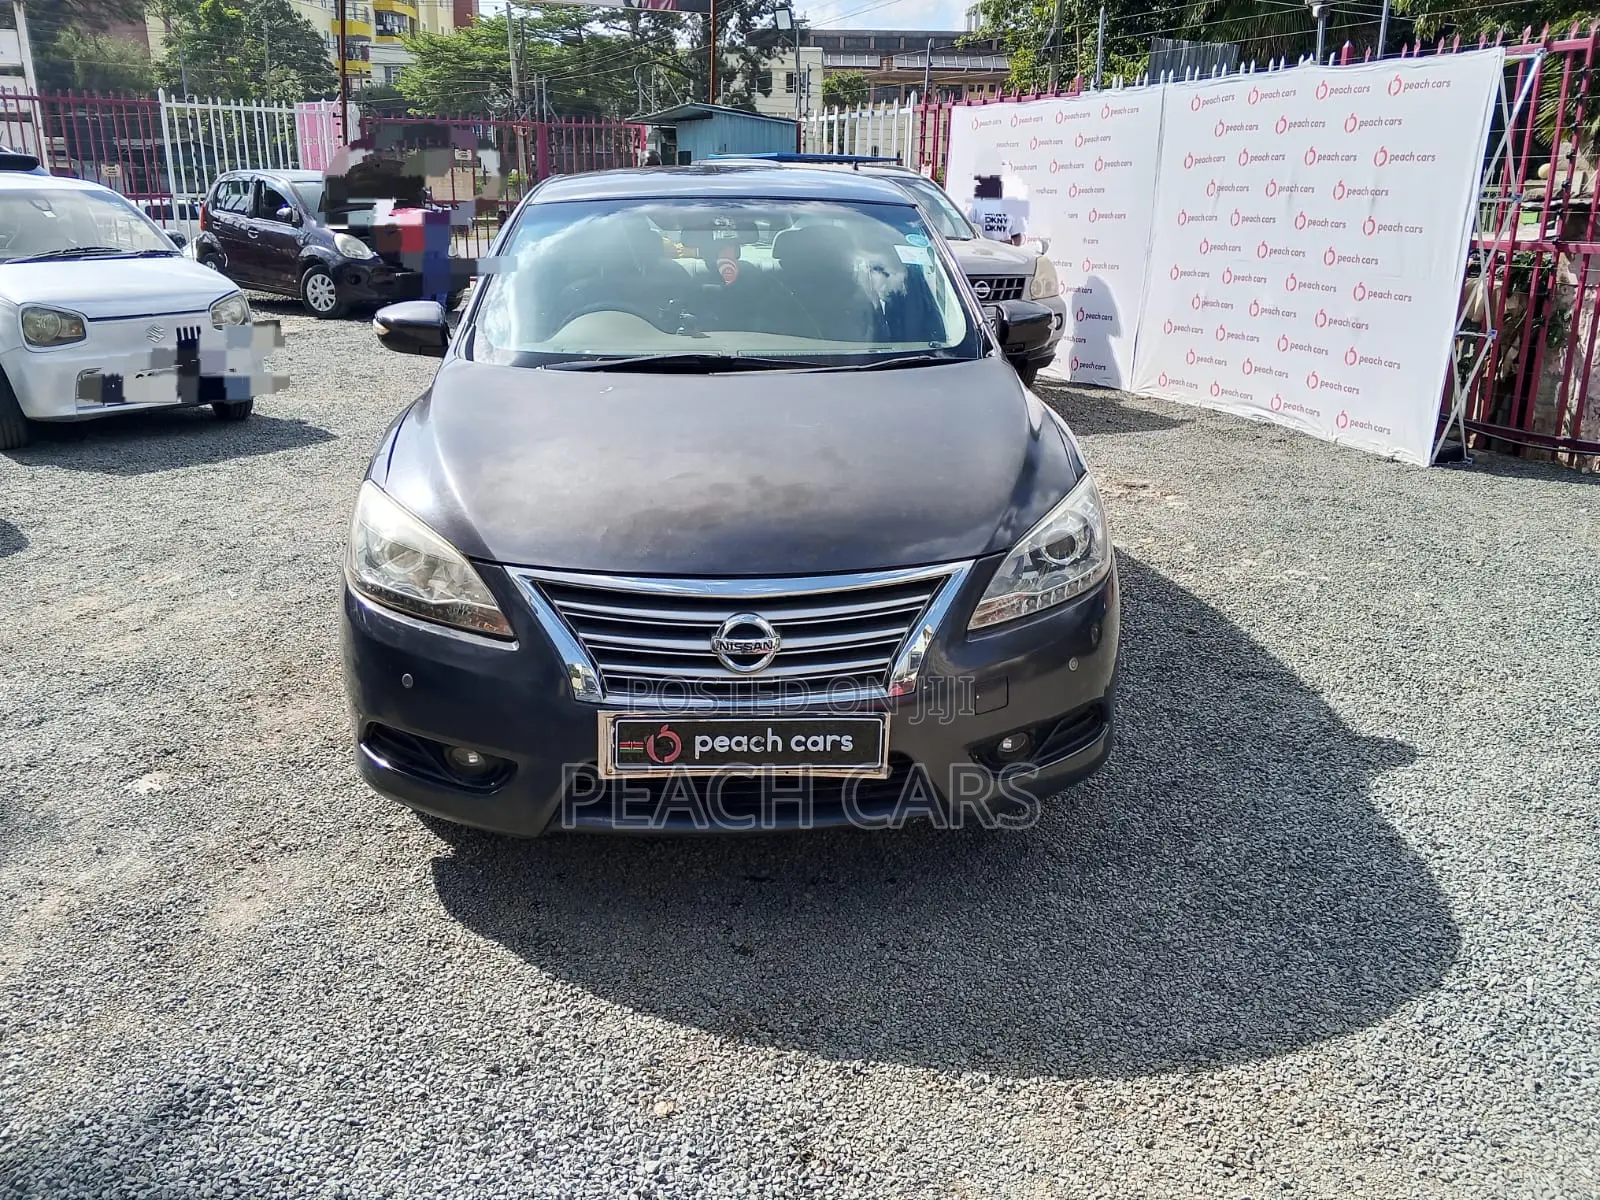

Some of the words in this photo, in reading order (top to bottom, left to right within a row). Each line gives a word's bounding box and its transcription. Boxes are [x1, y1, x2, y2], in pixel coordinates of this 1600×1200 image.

[1329, 85, 1352, 98] peach
[1353, 85, 1371, 94] cars
[1403, 78, 1430, 93] peach
[1432, 79, 1451, 88] cars
[1260, 89, 1281, 101] peach
[1281, 88, 1297, 97] cars
[1201, 95, 1220, 108] peach
[1221, 94, 1235, 102] cars
[1226, 122, 1244, 133] peach
[1245, 123, 1259, 131] cars
[1288, 118, 1310, 132] peach
[1310, 120, 1326, 128] cars
[1358, 116, 1382, 130] peach
[1384, 118, 1403, 126] cars
[1194, 153, 1212, 165] peach
[1250, 152, 1269, 164] peach
[1270, 153, 1286, 161] cars
[1317, 152, 1339, 164] peach
[1341, 153, 1357, 162] cars
[1389, 152, 1414, 164] peach
[1417, 153, 1436, 162] cars
[1217, 183, 1235, 193] peach
[1236, 184, 1249, 192] cars
[1278, 184, 1298, 196] peach
[1299, 185, 1315, 193] cars
[1347, 186, 1369, 198] peach
[1370, 188, 1389, 197] cars
[1187, 213, 1205, 224] peach
[1241, 212, 1261, 224] peach
[1261, 215, 1276, 223] cars
[1307, 218, 1329, 228] peach
[1330, 220, 1346, 229] cars
[985, 224, 1008, 232] DKNY
[1377, 222, 1402, 234] peach
[1404, 225, 1423, 234] cars
[1210, 241, 1228, 252] peach
[1228, 244, 1241, 252] cars
[1269, 246, 1290, 259] peach
[1290, 249, 1306, 258] cars
[1337, 254, 1360, 265] peach
[1361, 256, 1378, 265] cars
[1091, 261, 1107, 271] peach
[1180, 269, 1197, 279] peach
[1233, 273, 1252, 283] peach
[1253, 275, 1267, 284] cars
[1298, 280, 1320, 291] peach
[1321, 284, 1337, 293] cars
[1368, 289, 1392, 300] peach
[1394, 293, 1412, 302] cars
[1201, 298, 1220, 308] peach
[1221, 301, 1234, 310] cars
[1085, 312, 1101, 321] peach
[1260, 306, 1280, 316] peach
[1281, 309, 1297, 318] cars
[1173, 324, 1190, 334] peach
[1191, 326, 1203, 334] cars
[1328, 317, 1350, 327] peach
[1351, 320, 1369, 330] cars
[1226, 331, 1245, 341] peach
[1246, 334, 1260, 343] cars
[1290, 341, 1312, 352] peach
[1313, 347, 1328, 356] cars
[1079, 361, 1095, 369] peach
[1095, 363, 1106, 371] cars
[1196, 354, 1214, 364] peach
[1215, 358, 1227, 366] cars
[1358, 355, 1382, 366] peach
[1383, 360, 1400, 370] cars
[1254, 365, 1273, 376] peach
[1274, 370, 1289, 379] cars
[1168, 377, 1185, 387] peach
[1186, 382, 1198, 390] cars
[1320, 380, 1342, 391] peach
[1343, 385, 1359, 395] cars
[1221, 387, 1239, 397] peach
[1240, 392, 1253, 400] cars
[1283, 402, 1304, 413] peach
[1305, 407, 1320, 417] cars
[1350, 419, 1373, 430] peach
[1374, 424, 1391, 435] cars
[719, 640, 773, 652] NISSAN
[694, 727, 783, 760] peach
[790, 734, 854, 752] cars
